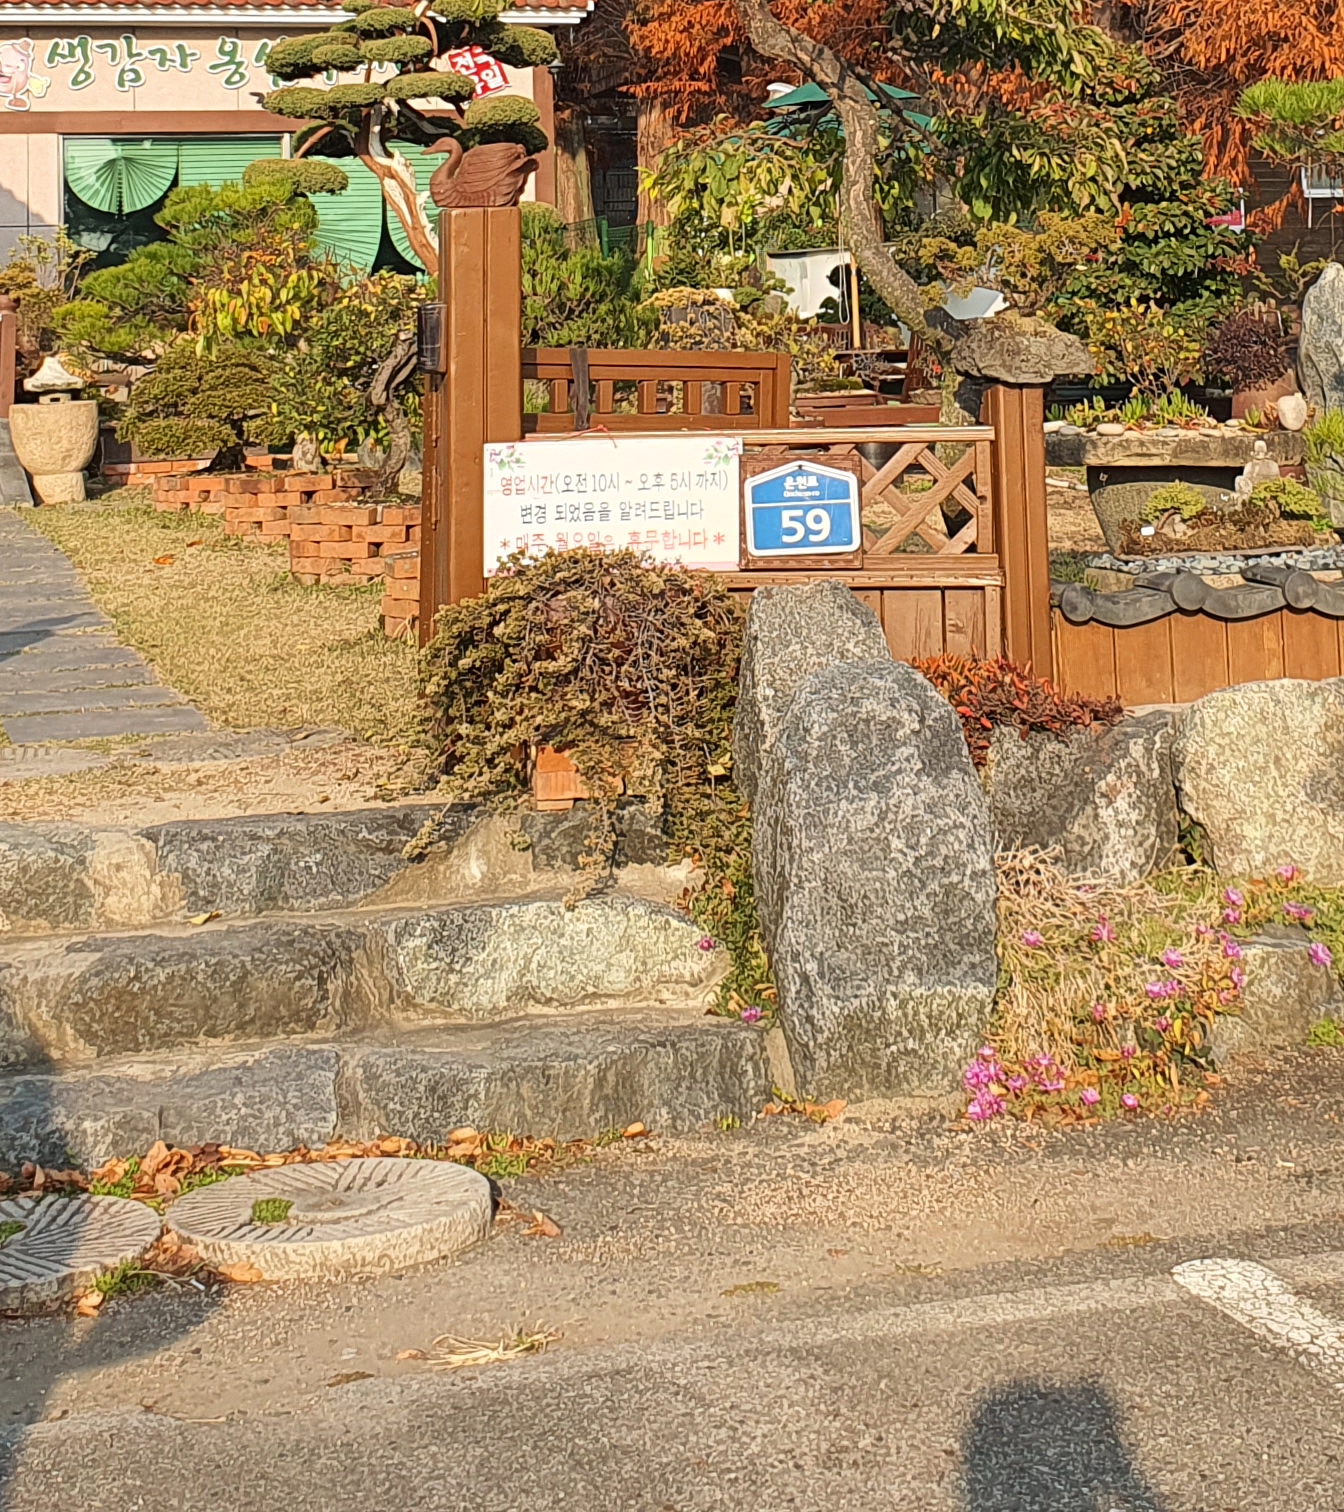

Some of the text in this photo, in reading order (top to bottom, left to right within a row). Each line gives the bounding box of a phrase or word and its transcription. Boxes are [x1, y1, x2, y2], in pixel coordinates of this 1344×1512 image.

[45, 34, 201, 90] 생감자
[638, 471, 665, 491] 오후
[520, 499, 705, 525] 변경 되었음을 알려드립니다
[781, 508, 831, 544] 59
[516, 533, 546, 552] 매주
[627, 528, 708, 551] 휴무합니다
